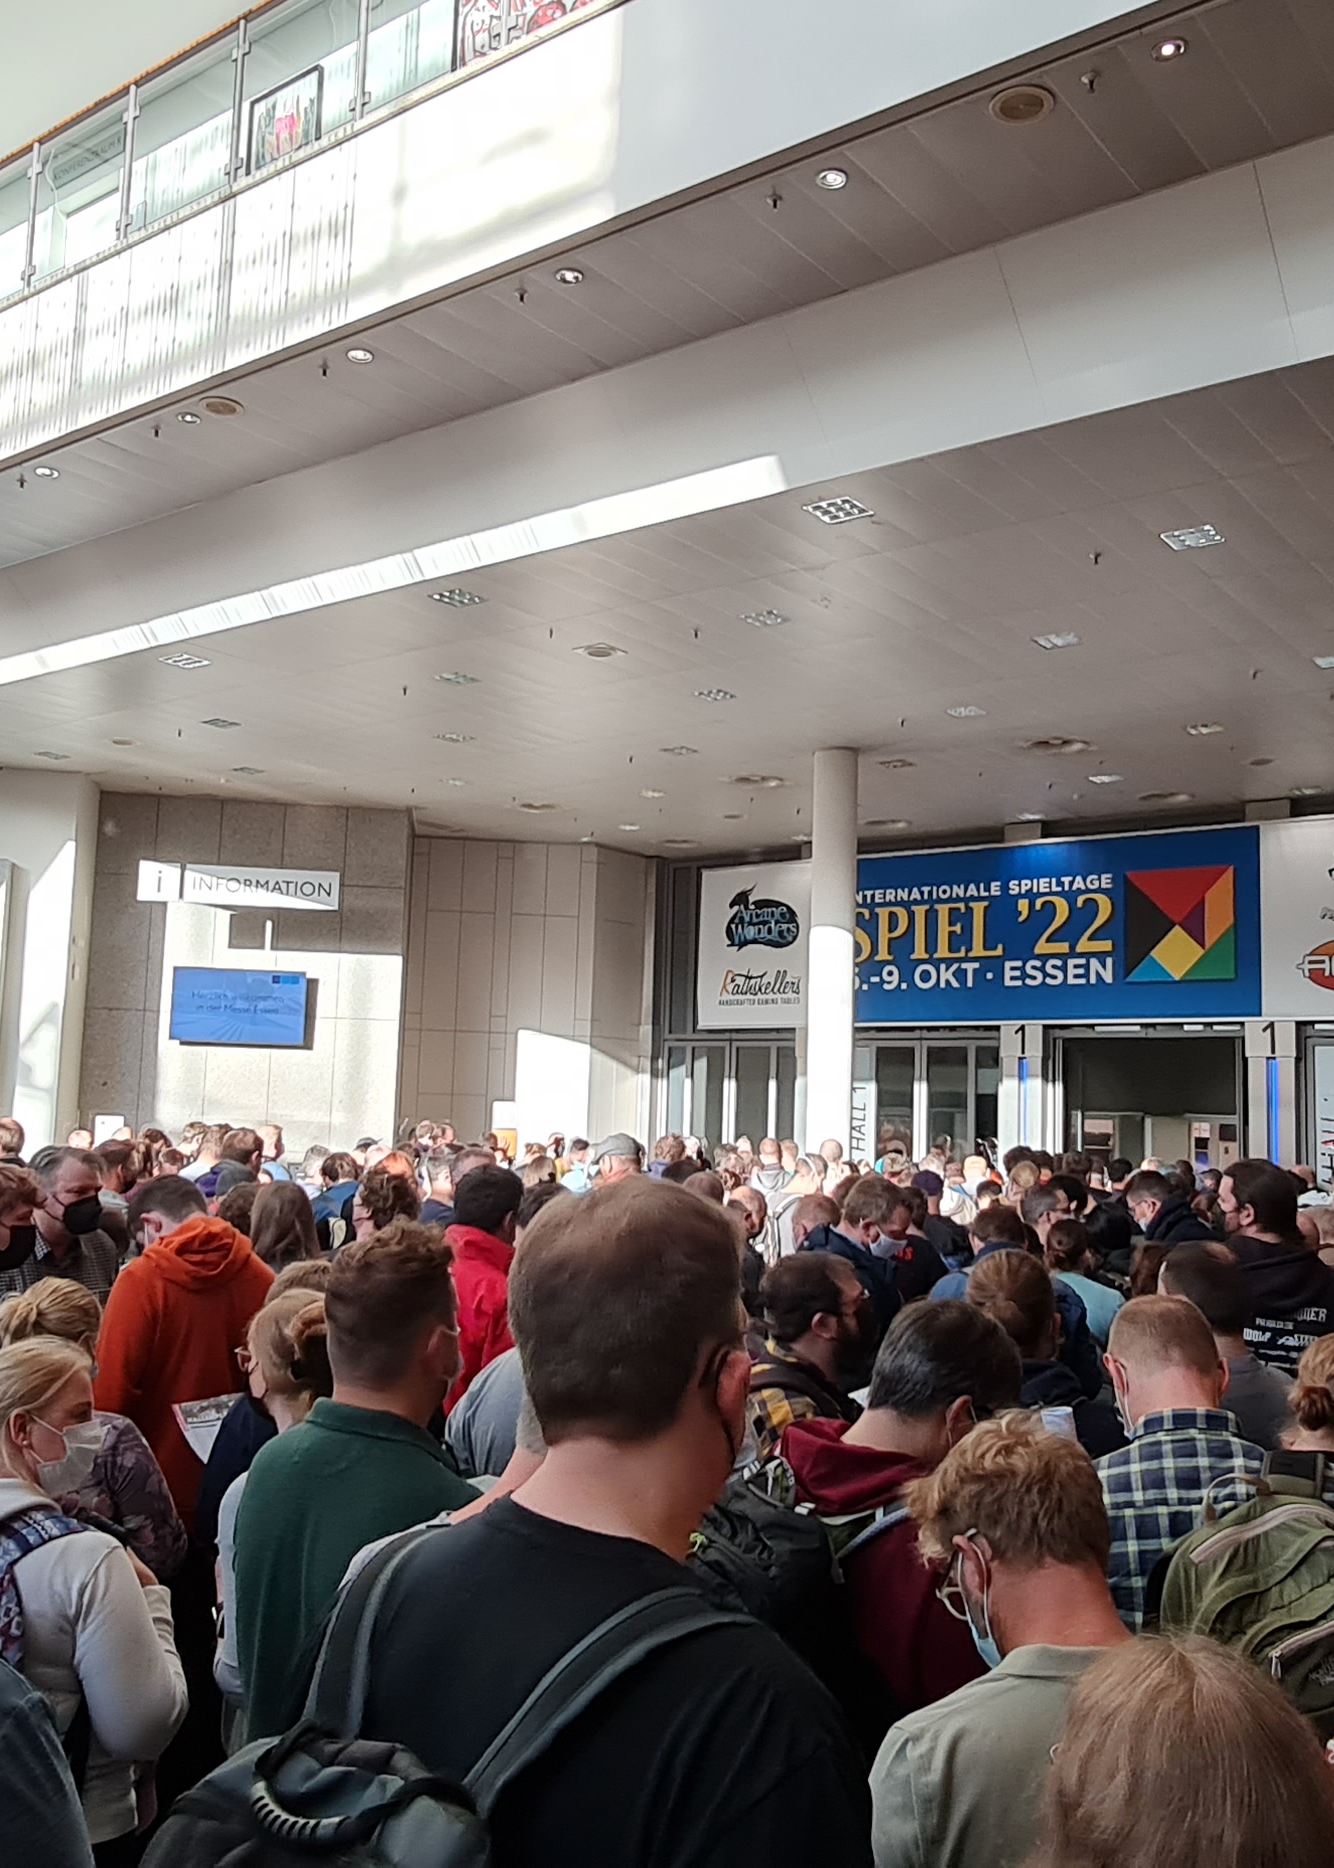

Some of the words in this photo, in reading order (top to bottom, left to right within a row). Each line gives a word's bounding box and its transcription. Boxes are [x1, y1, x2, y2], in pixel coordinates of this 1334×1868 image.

[157, 870, 162, 893] i
[192, 876, 332, 898] INFORMATION
[855, 881, 1001, 904] NTERNATIONALE
[1008, 873, 1113, 895] SPIELTAGE
[734, 904, 789, 922] Arcane
[855, 901, 1004, 964] SPIEL
[1017, 893, 1114, 955] '22
[730, 920, 797, 945] Wonders
[913, 962, 980, 989] OKT
[1003, 957, 1114, 987] ESSEN
[1014, 1024, 1026, 1055] 1
[1261, 1021, 1276, 1055] 1
[852, 1085, 867, 1094] 1
[851, 1101, 867, 1152] HALL
